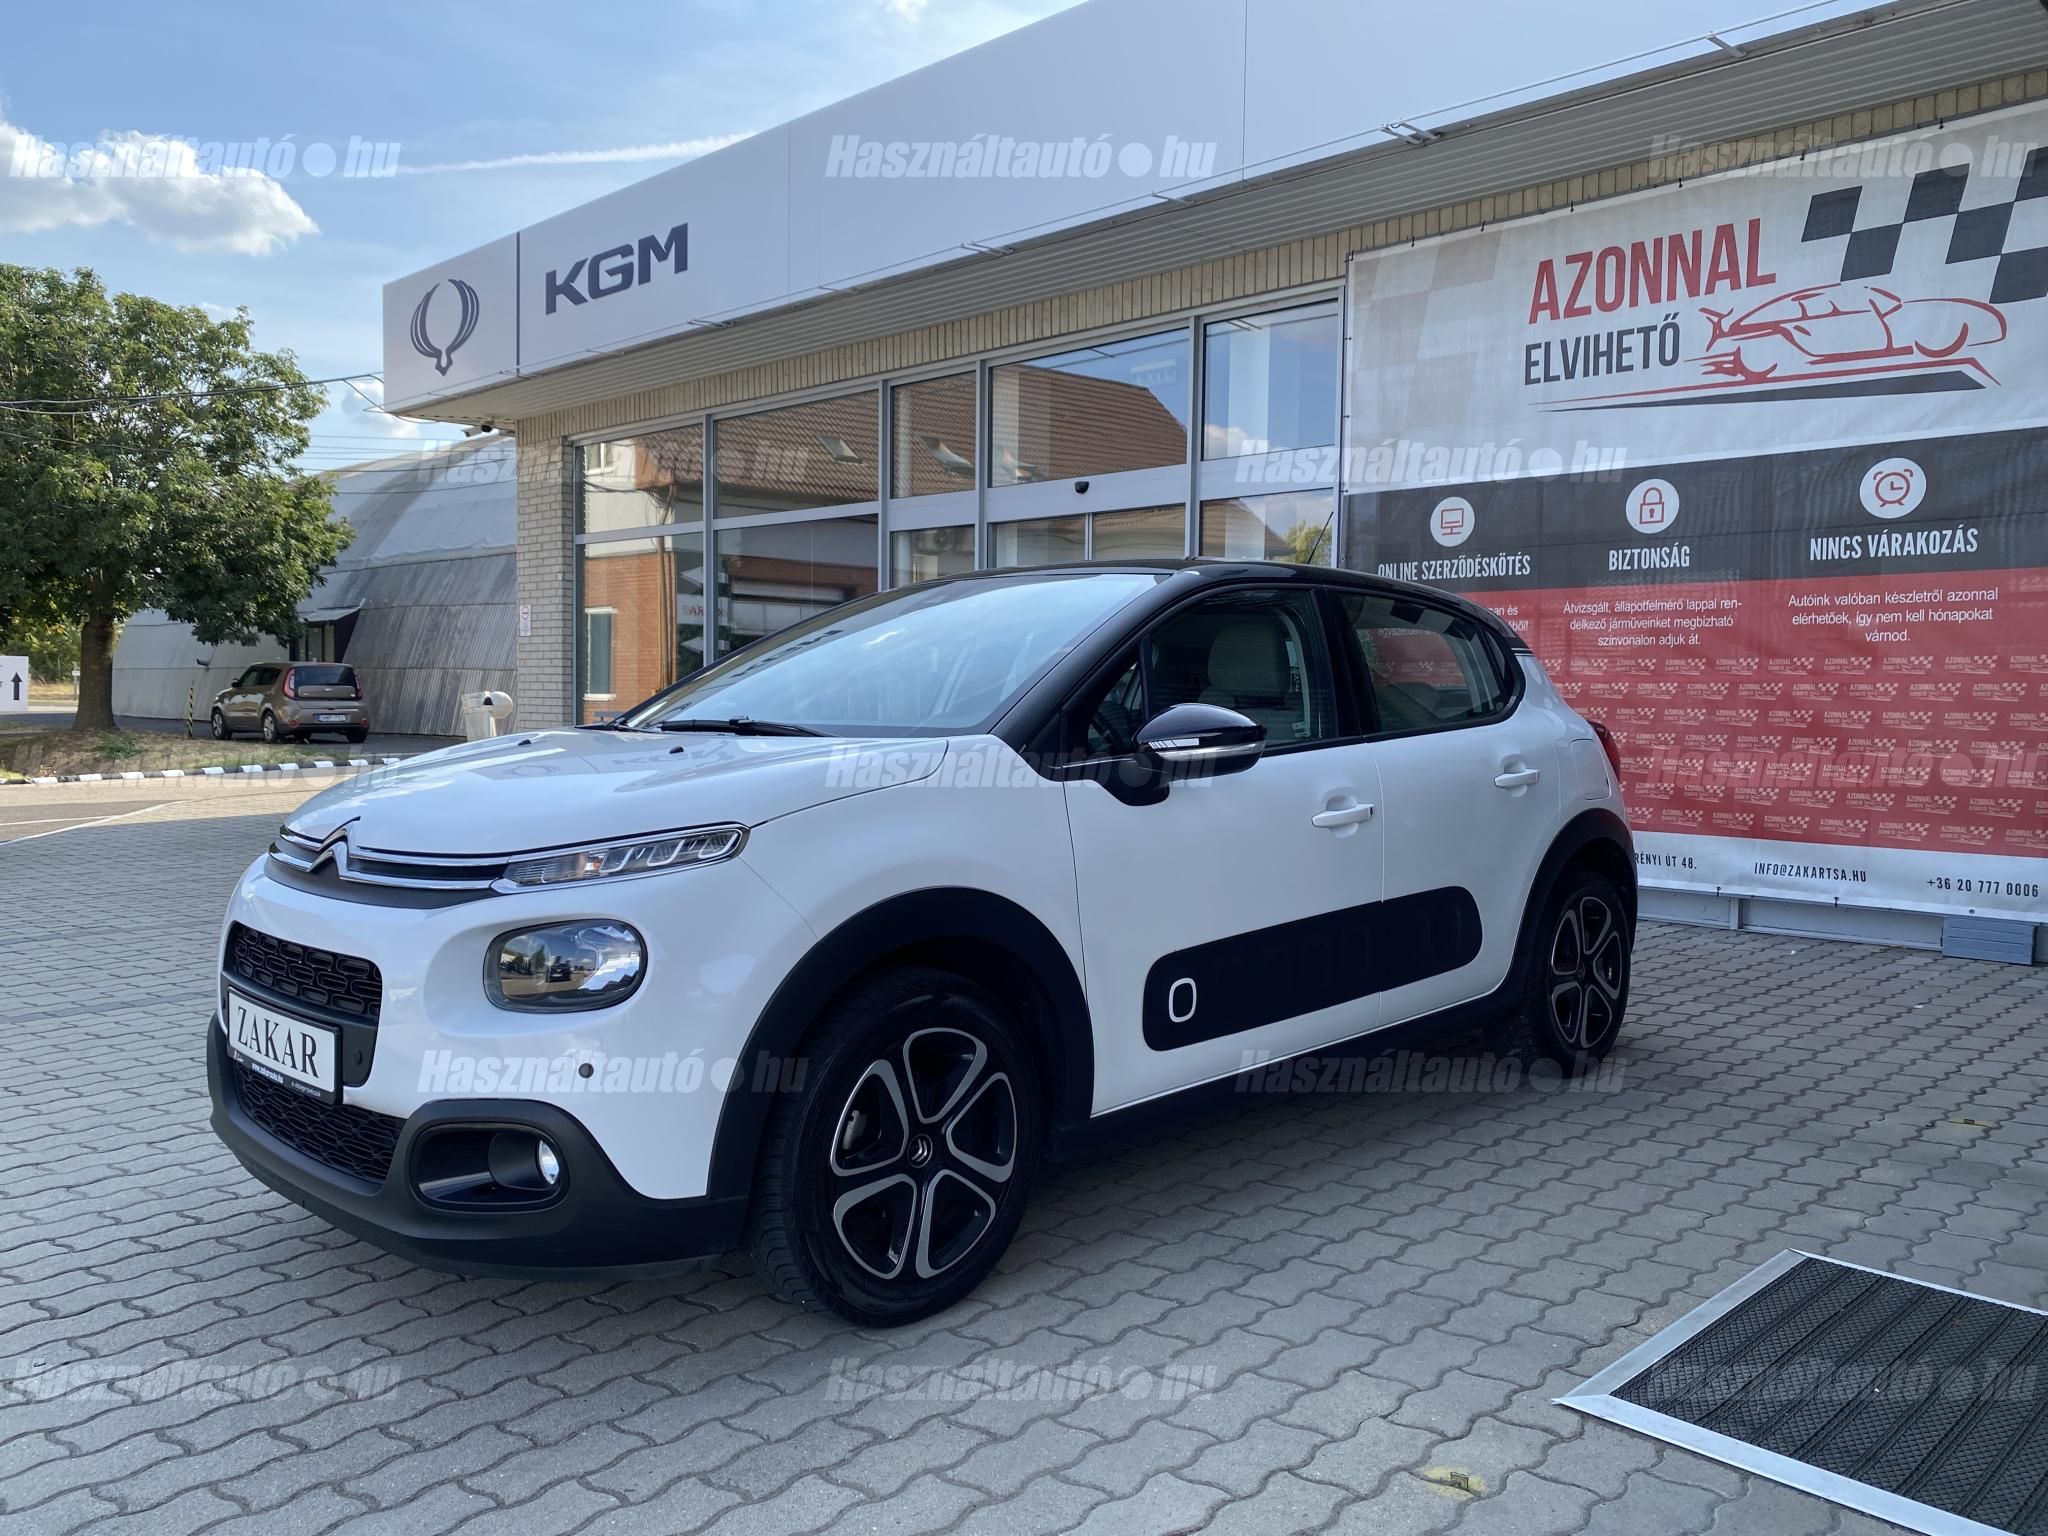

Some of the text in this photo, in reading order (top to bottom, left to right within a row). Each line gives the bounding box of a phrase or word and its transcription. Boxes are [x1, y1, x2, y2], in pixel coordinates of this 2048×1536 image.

[545, 222, 688, 315] KGM
[1528, 218, 1776, 324] AZONNAL
[1525, 312, 1680, 385] ELVIHETŐ
[1809, 524, 1978, 561] NINCS VÁRAKOZÁS
[1421, 552, 1531, 580] SZERZŐDÉSKÖTÉS
[1608, 542, 1690, 571] BIZTONSÁG
[1614, 600, 1683, 614] állapotfelmérő
[1686, 598, 1717, 612] lappal
[1788, 587, 1998, 607] Autóink valóban készletről azonnal
[1570, 617, 1607, 630] delkező
[1674, 615, 1734, 630] megbízható
[1792, 610, 1852, 625] elérhetőek,
[1876, 612, 1901, 623] nem
[1906, 609, 1924, 622] kell
[1928, 608, 1993, 623] hónapokat
[1659, 634, 1685, 648] adjuk
[1865, 629, 1910, 642] várnod.
[1635, 853, 1697, 869] RÉNYI ÚT 48.
[1754, 862, 1867, 882] INFO@ZAKARTSA.HU
[1927, 877, 2039, 897] +36 20 777 0006
[237, 1005, 320, 1079] ZAKAR
